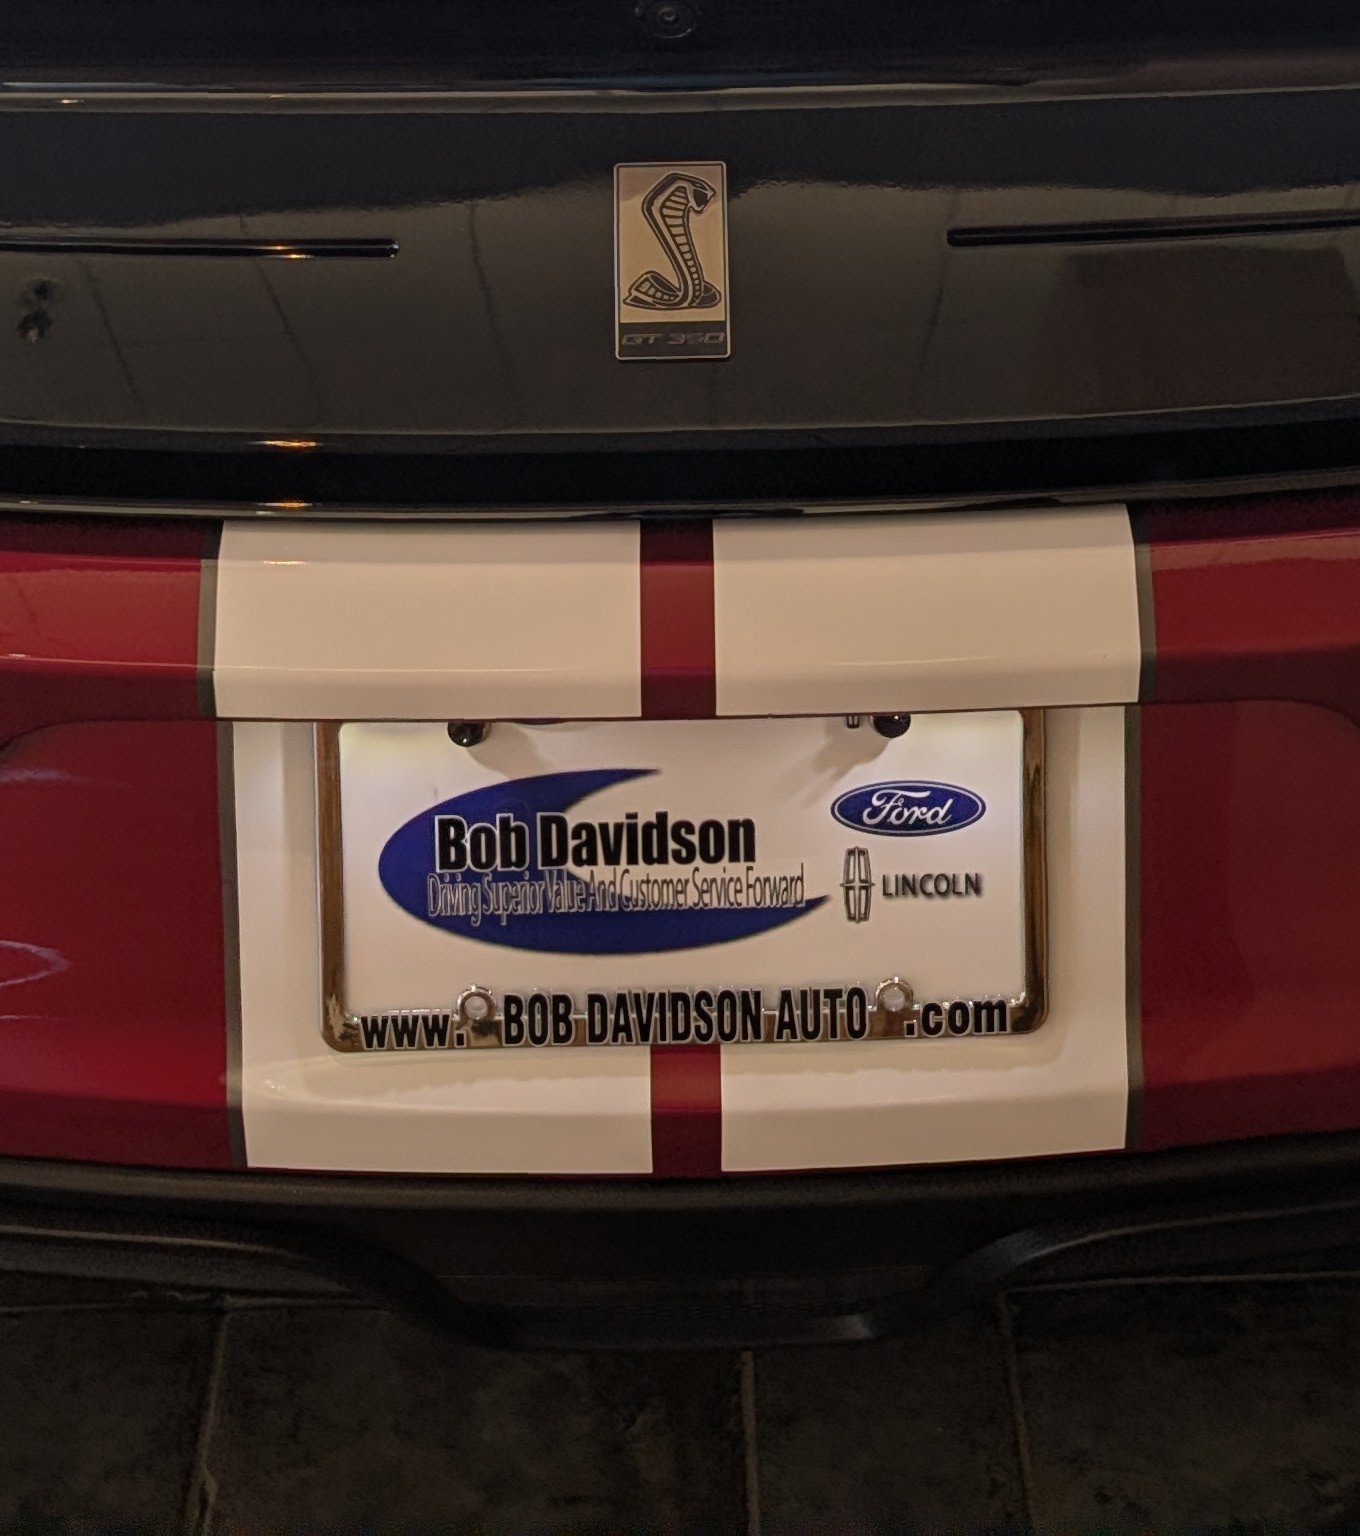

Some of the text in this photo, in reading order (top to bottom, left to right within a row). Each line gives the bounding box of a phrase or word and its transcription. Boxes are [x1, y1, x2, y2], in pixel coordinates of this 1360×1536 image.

[621, 332, 664, 346] GT
[861, 789, 954, 827] Ford
[435, 811, 757, 872] Bob Davidson
[427, 862, 806, 926] Driving Superior Value And Customer Service Forward
[881, 872, 983, 899] LINCOLN
[501, 992, 576, 1047] BOB
[586, 987, 763, 1046] DAVIDSON
[774, 985, 870, 1042] AUTO
